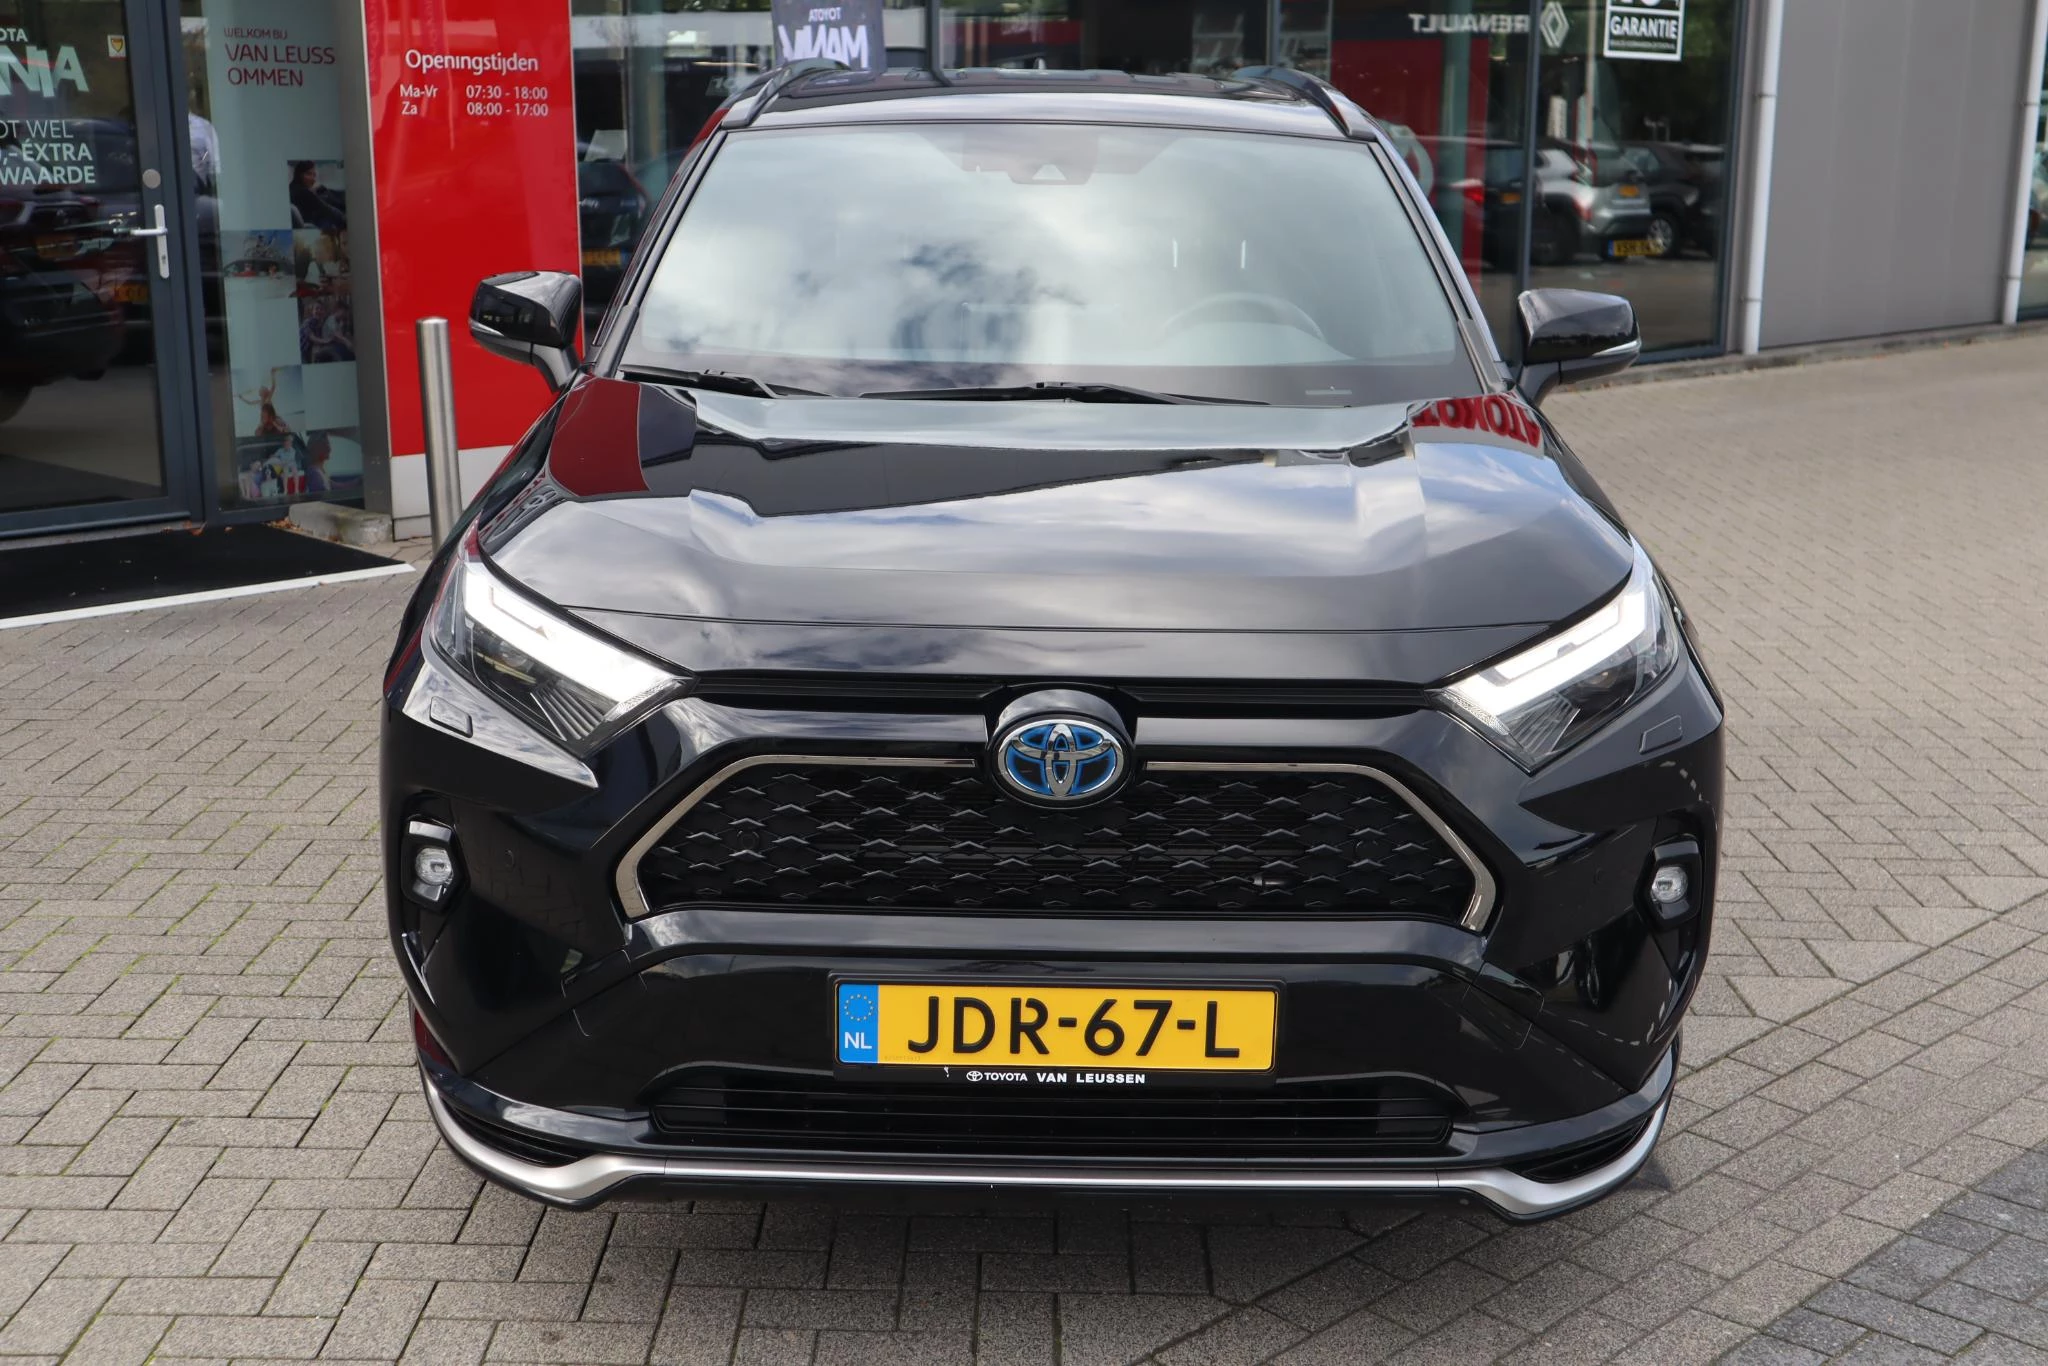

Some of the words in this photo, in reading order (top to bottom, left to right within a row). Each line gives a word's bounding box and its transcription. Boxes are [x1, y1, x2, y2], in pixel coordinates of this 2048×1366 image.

[224, 28, 270, 39] WELKOM
[273, 29, 288, 40] BIJ
[1610, 15, 1678, 39] GARANTIE
[225, 44, 268, 62] VAN
[405, 49, 538, 76] Openingstijden
[227, 67, 304, 87] OMMEN
[400, 84, 438, 98] Ma-Vr
[466, 85, 501, 99] 07:30
[514, 86, 548, 100] 18:00
[401, 101, 418, 115] Za
[467, 102, 502, 116] 08:00
[515, 103, 548, 117] 17:00
[26, 120, 74, 138] WEL
[907, 996, 1240, 1059] JDR-67-L
[844, 1032, 873, 1050] NL
[984, 1072, 1028, 1082] TOYOTA
[1036, 1072, 1067, 1083] VAN
[1076, 1073, 1146, 1084] LEUSSEN
